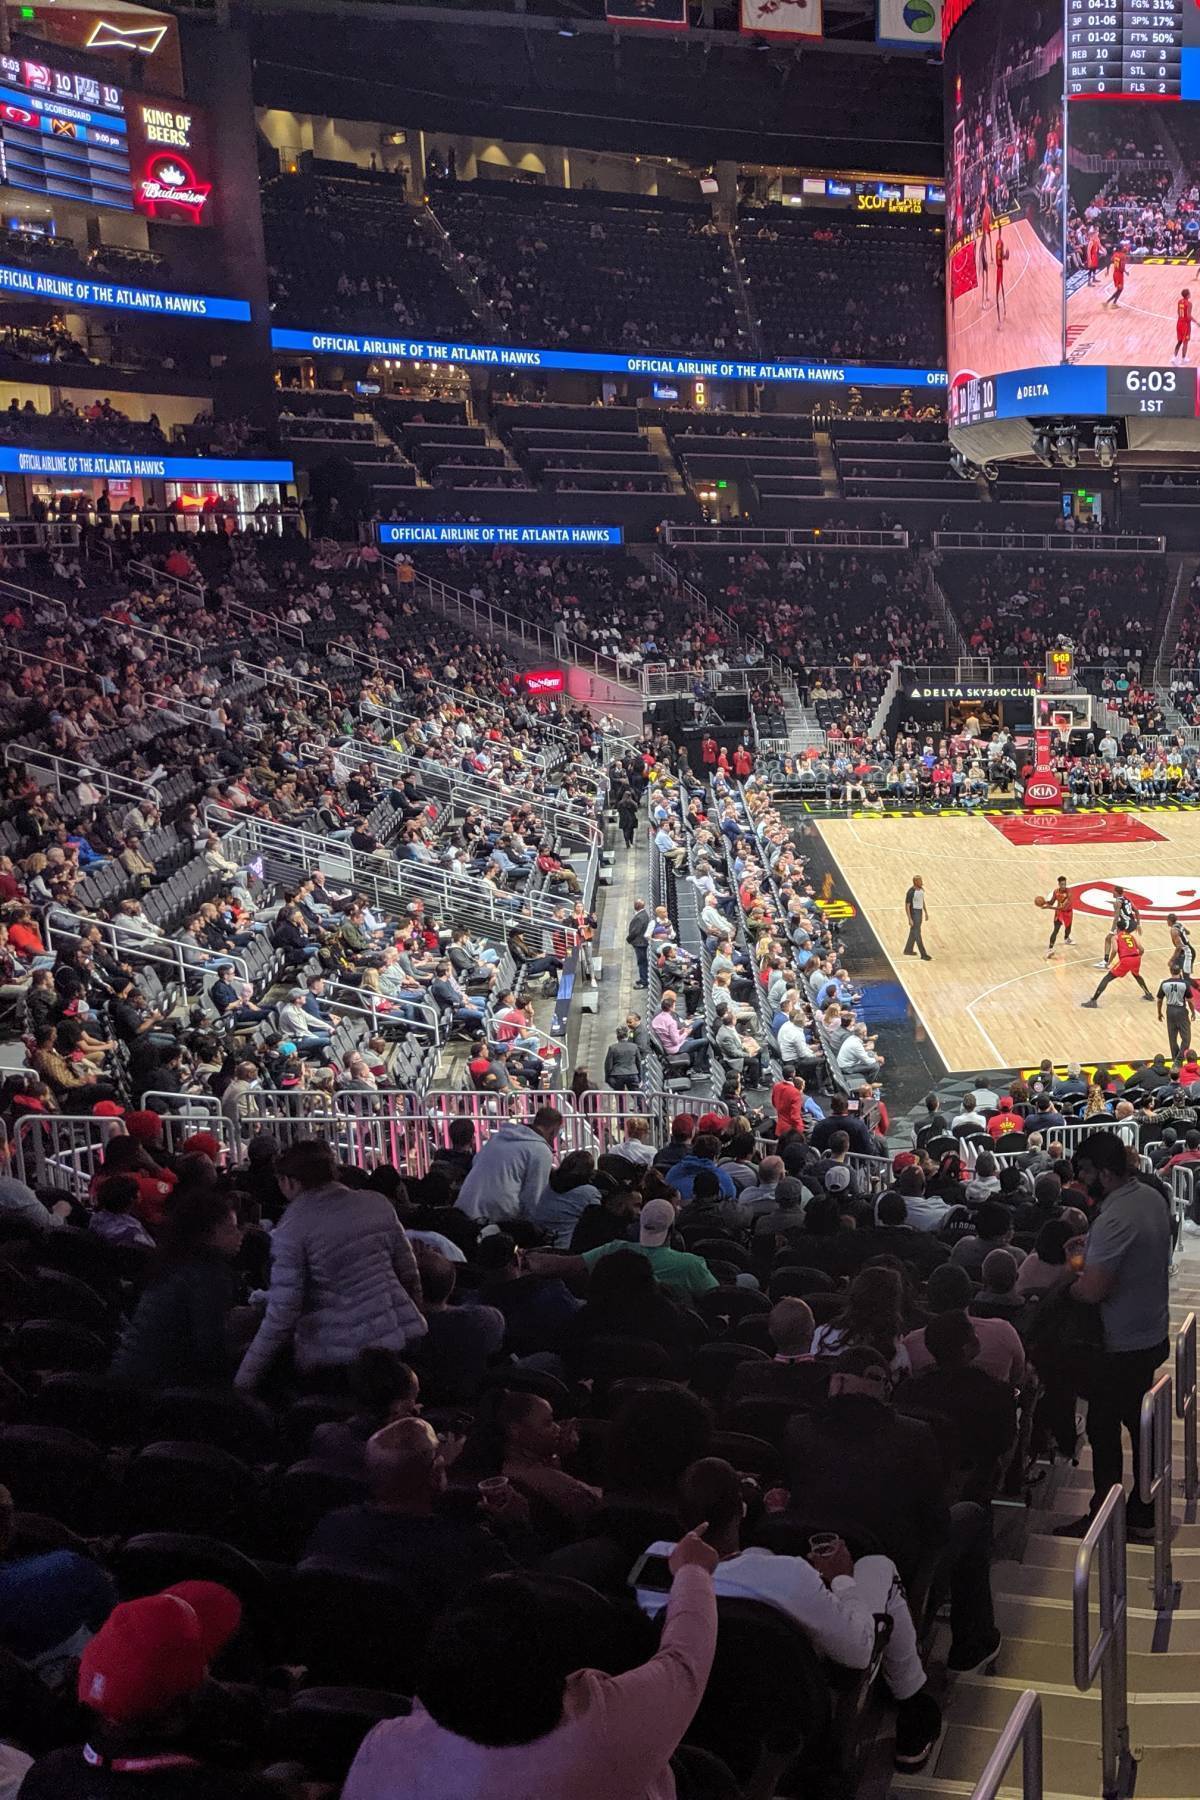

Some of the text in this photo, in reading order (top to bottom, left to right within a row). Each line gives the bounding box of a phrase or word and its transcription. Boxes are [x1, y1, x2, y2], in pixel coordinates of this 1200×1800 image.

[1072, 15, 1175, 27] 3P 01-06 3P% 17%
[1072, 32, 1174, 43] FT 01-02 FT% 50%
[1072, 49, 1167, 60] REB 10 AST 3
[2, 57, 20, 73] 6:03
[1071, 65, 1166, 76] BLK 1 STL 0
[55, 73, 71, 91] 10
[1072, 82, 1166, 93] TO 0 FLS 2
[103, 86, 119, 104] 10
[44, 102, 92, 122] SCOREBOARD
[143, 107, 173, 128] KING
[175, 114, 191, 131] OF
[95, 132, 120, 145] 9:00 pm
[147, 125, 190, 147] BEERS.
[141, 181, 207, 203] Budweiser
[36, 276, 73, 296] AIRLINE
[76, 284, 89, 298] OF
[92, 286, 112, 302] THE
[116, 289, 162, 308] ATLANTA
[164, 296, 206, 313] HAWKS
[312, 336, 540, 364] OFFICIAL AIRLINE OF THE ATLANTA HAWKS
[628, 359, 844, 380] OFFICIAL AIRLINE OF THE ATLANTA HAWKS
[1126, 370, 1176, 392] 6:03
[982, 380, 993, 409] 10
[1023, 383, 1049, 398] DELTA
[1140, 400, 1164, 412] 1ST
[391, 528, 609, 540] OFFICIAL AIRLINE OF THE ATLANTA HAWKS
[1053, 653, 1070, 663] 6:03
[1056, 662, 1068, 676] 15
[923, 688, 963, 697] DELTA
[1032, 786, 1053, 797] KIA
[1126, 937, 1134, 948] 5
